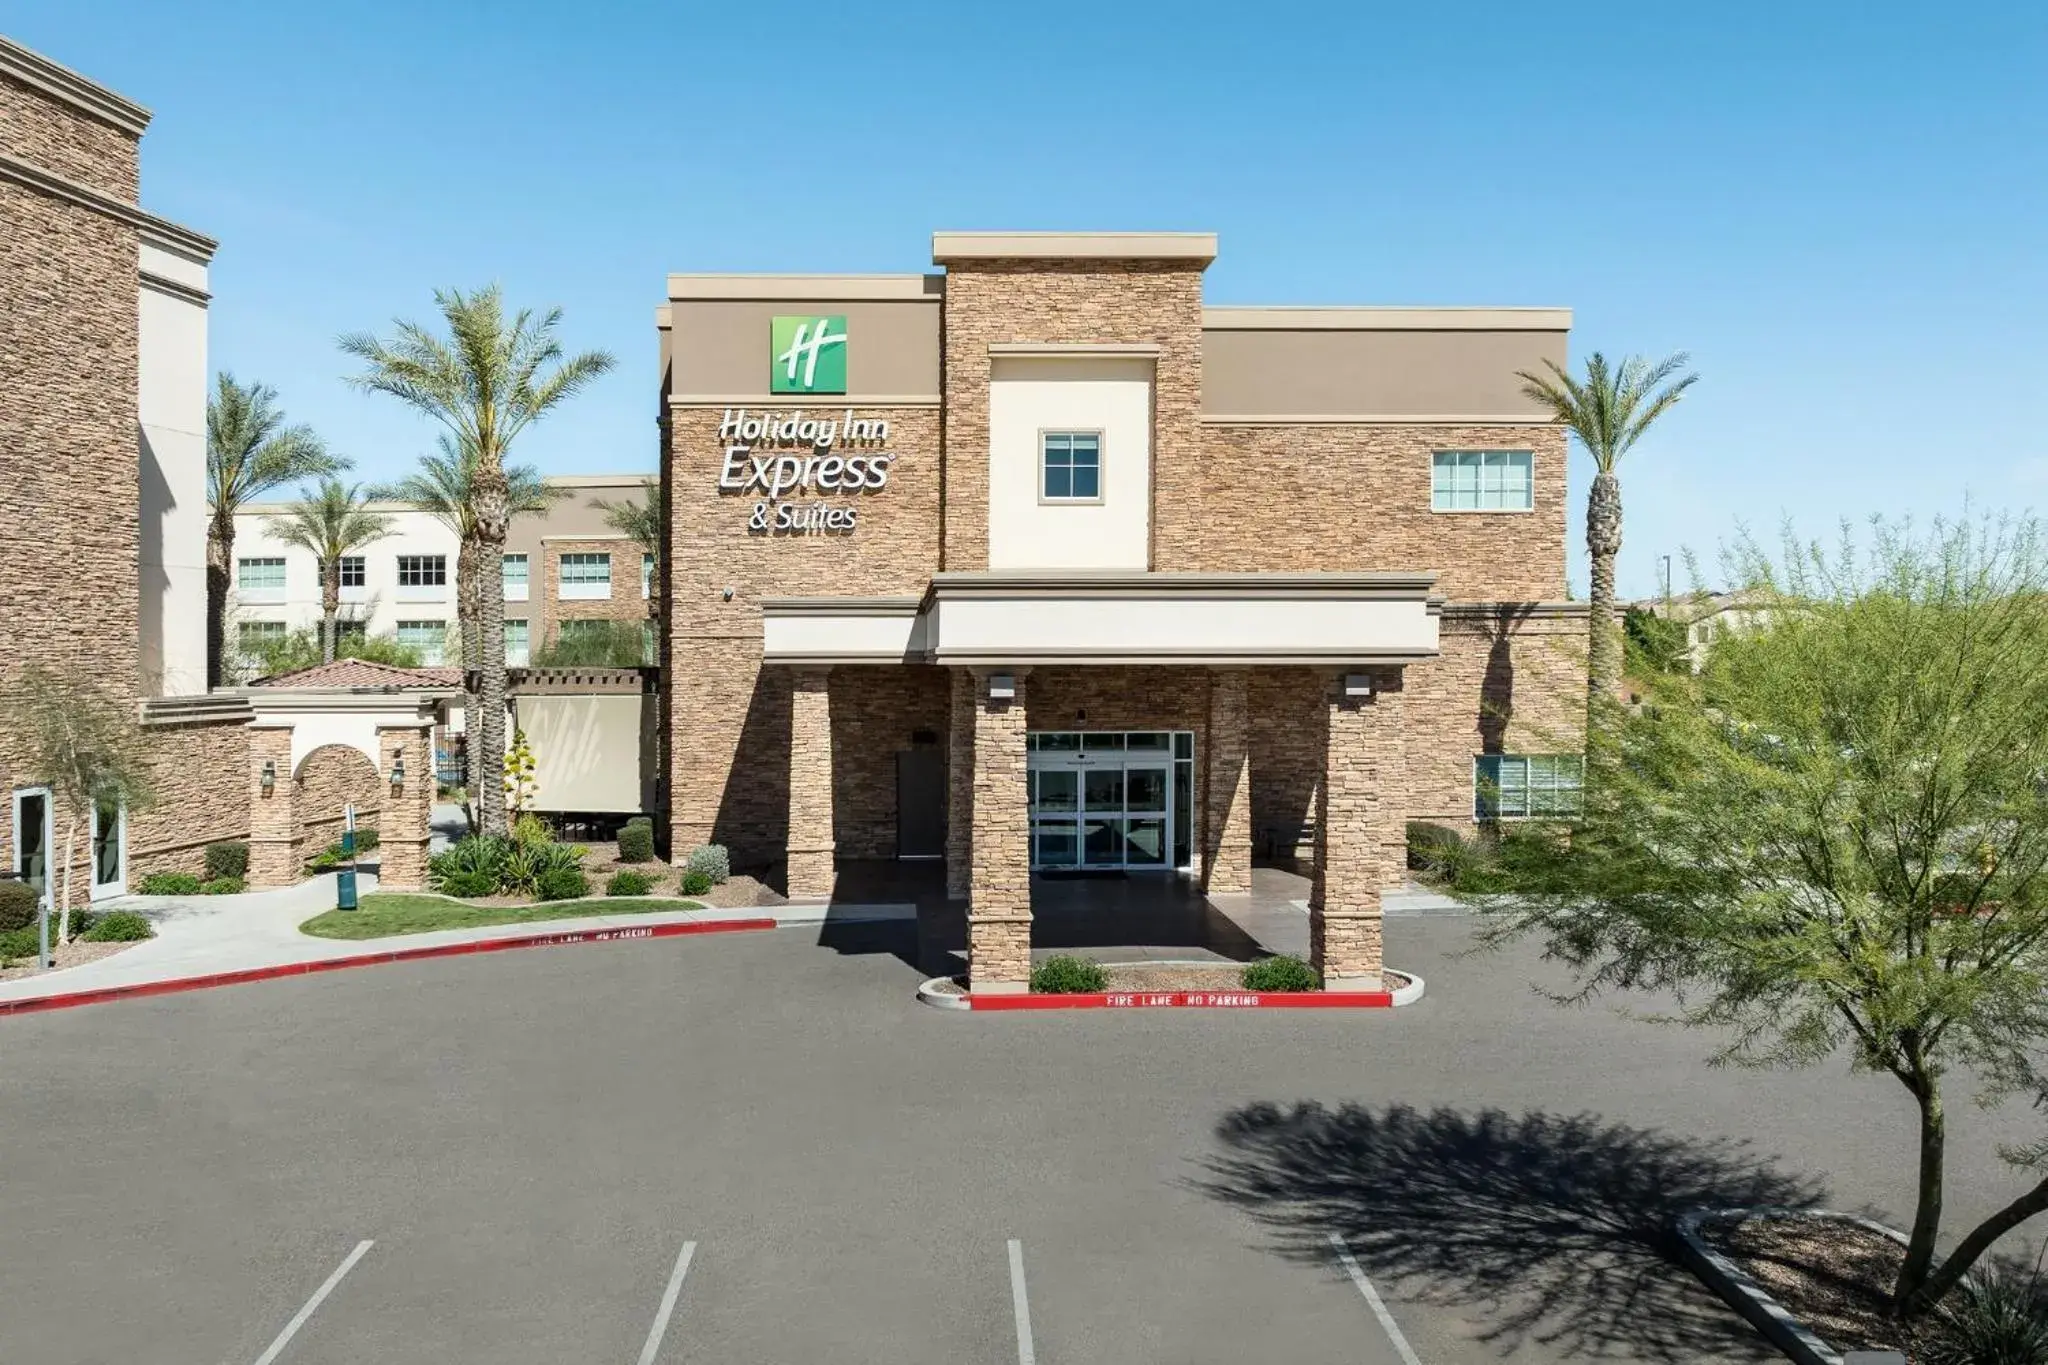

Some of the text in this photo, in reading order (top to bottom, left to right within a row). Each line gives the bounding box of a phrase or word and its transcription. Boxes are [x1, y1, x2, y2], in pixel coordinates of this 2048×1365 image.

[779, 319, 848, 388] H
[719, 408, 890, 447] Holiday Inn
[719, 445, 890, 500] Express
[749, 500, 857, 530] & Suites
[1106, 995, 1259, 1006] FIRE LANE NO PARKING
